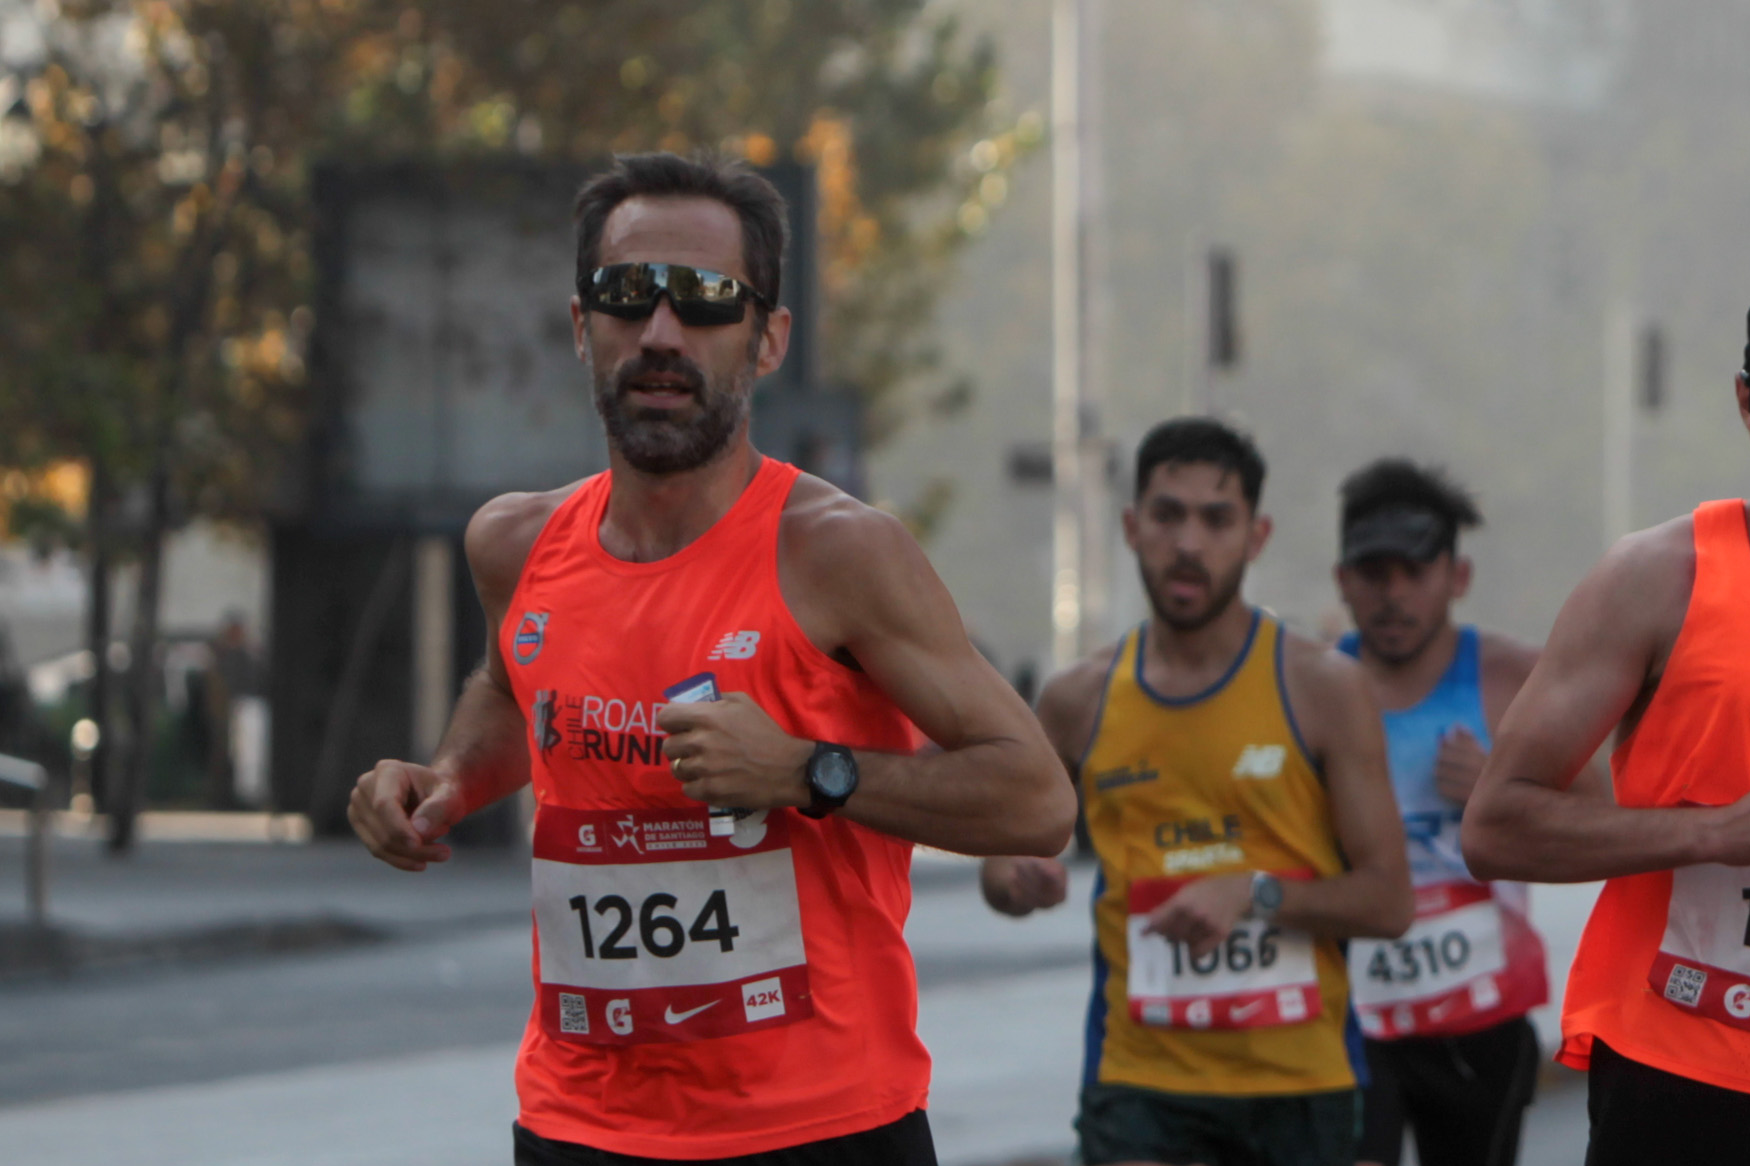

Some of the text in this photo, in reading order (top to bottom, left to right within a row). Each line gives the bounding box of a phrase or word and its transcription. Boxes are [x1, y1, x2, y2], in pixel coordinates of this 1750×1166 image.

[566, 694, 584, 761] CHILE
[643, 820, 705, 832] MARATÓN
[659, 832, 705, 841] SANTIAGO
[1154, 814, 1242, 848] CHILE
[569, 889, 740, 960] 1264
[1367, 930, 1471, 982] 4310
[745, 989, 782, 1009] 42K
